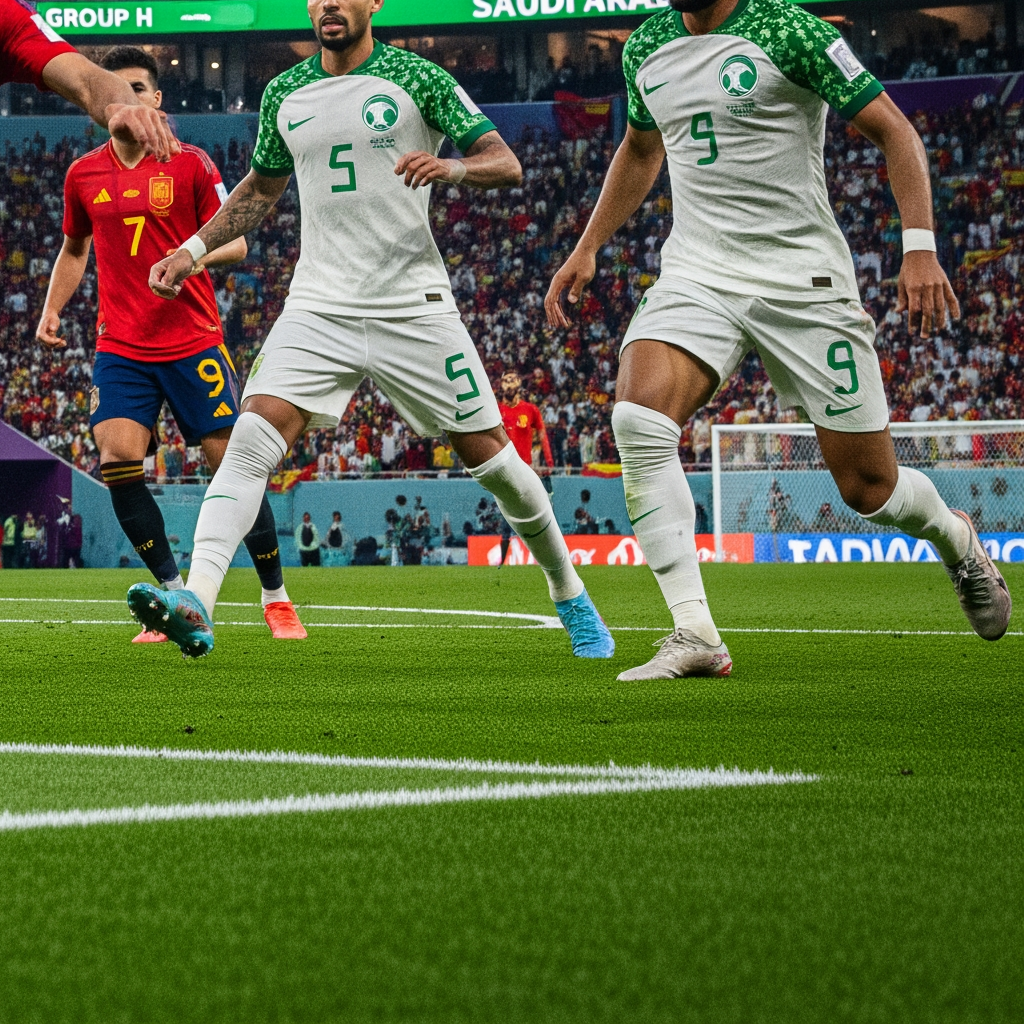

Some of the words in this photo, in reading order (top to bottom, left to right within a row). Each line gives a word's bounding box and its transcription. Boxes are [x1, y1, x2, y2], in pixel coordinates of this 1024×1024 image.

[45, 7, 130, 28] GROUP
[136, 7, 153, 28] H
[690, 111, 718, 166] 9
[328, 143, 357, 193] 5
[123, 215, 146, 257] 7
[197, 358, 225, 398] 9
[445, 352, 481, 403] 5
[827, 340, 859, 395] 9
